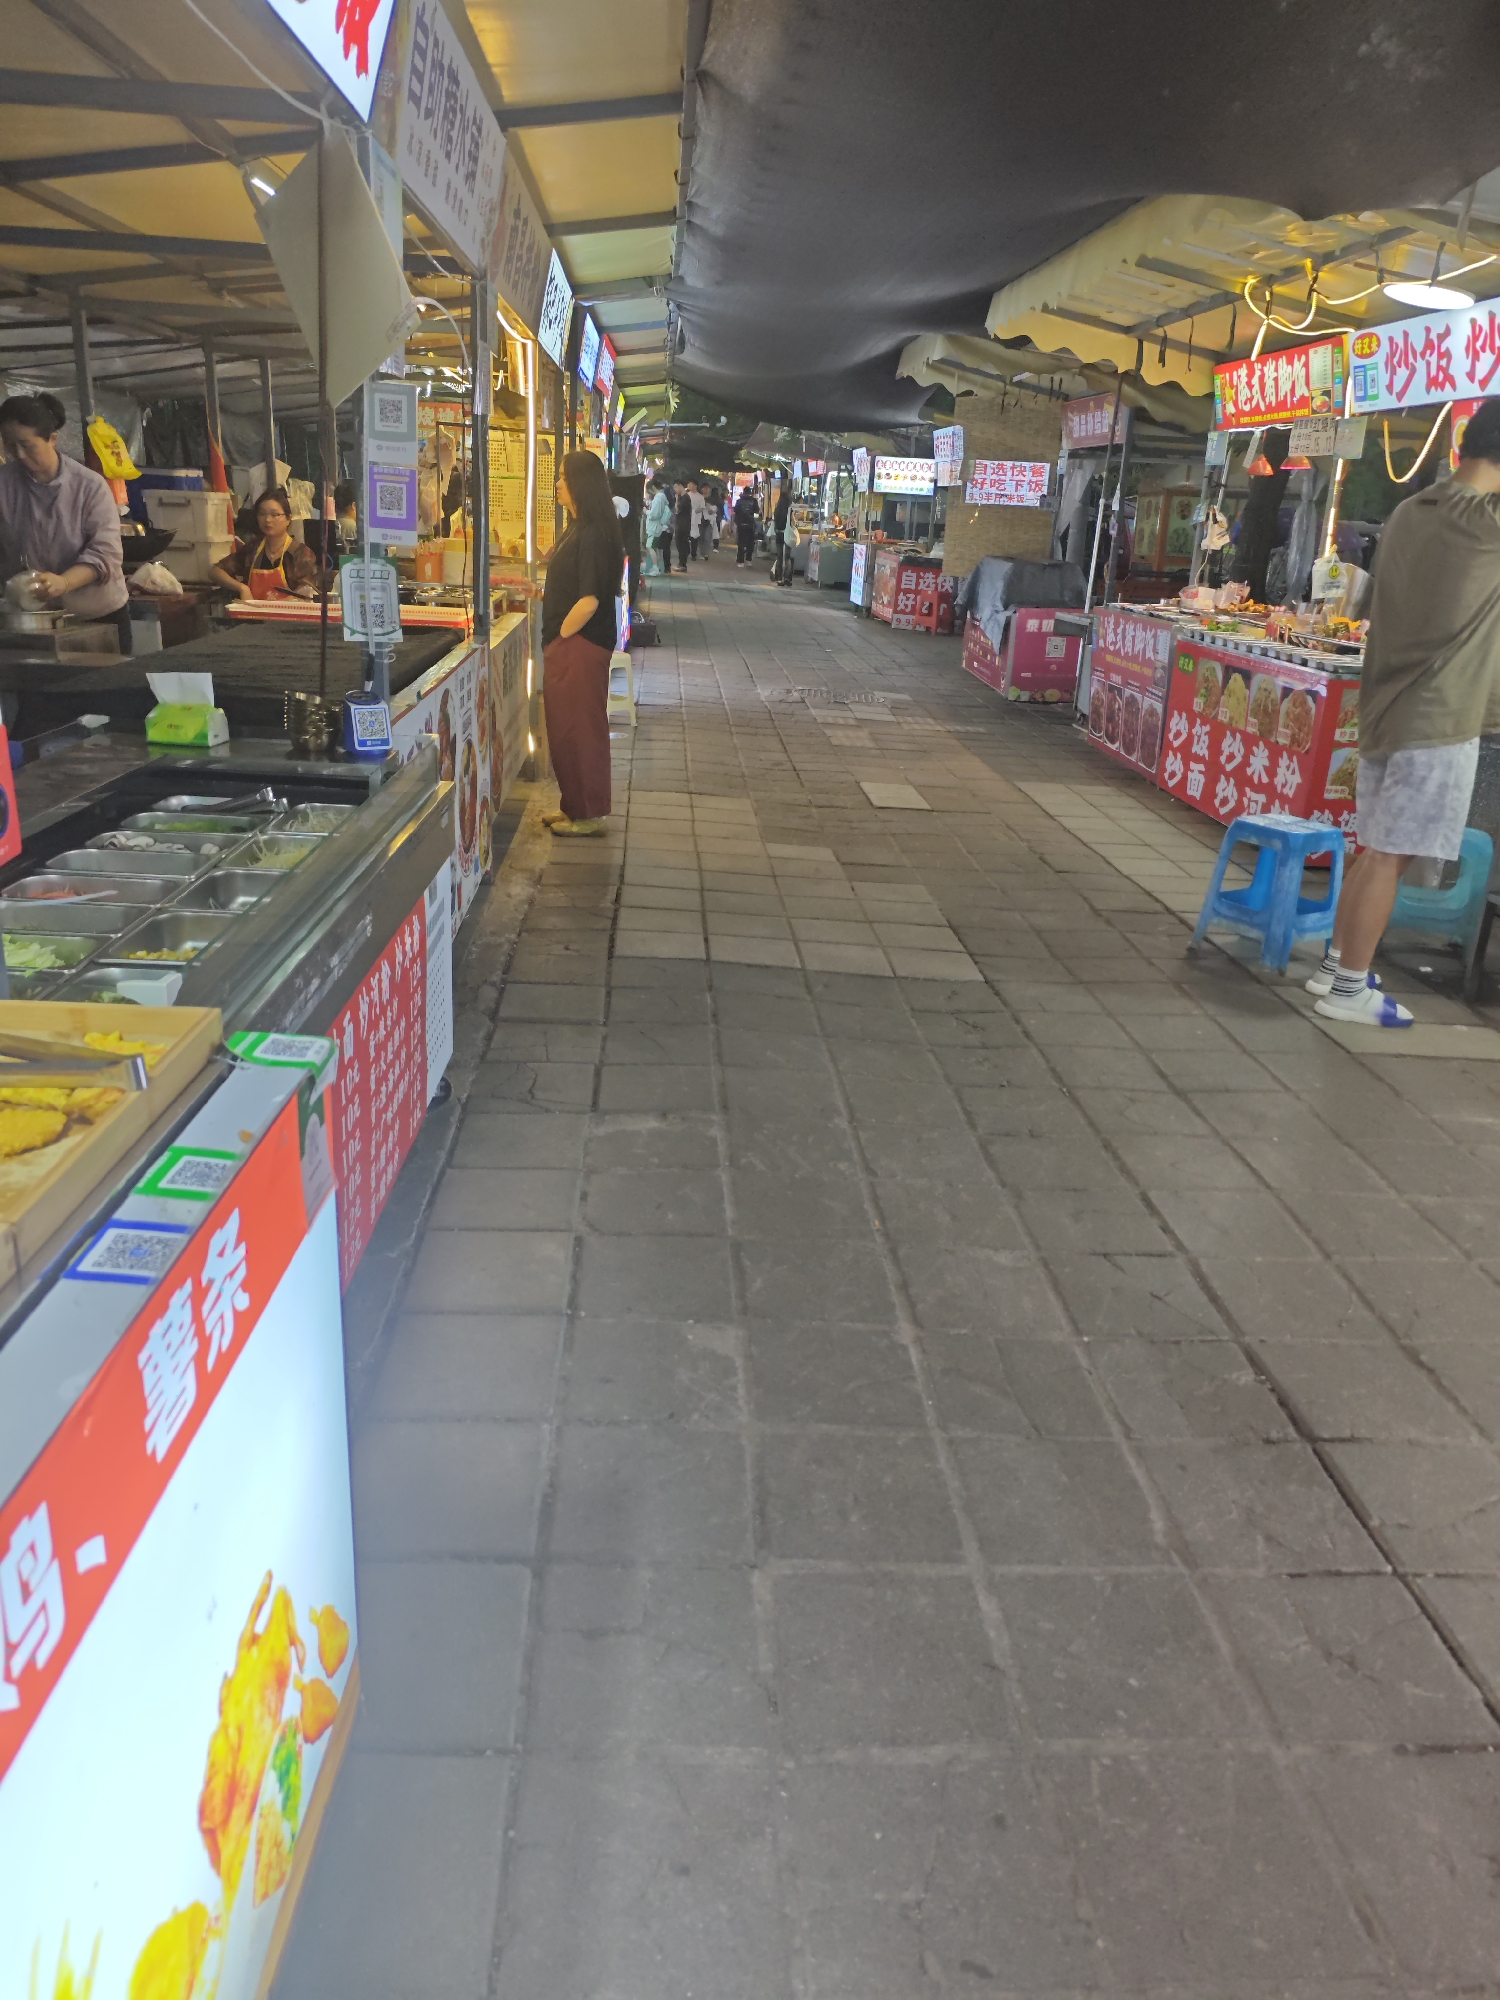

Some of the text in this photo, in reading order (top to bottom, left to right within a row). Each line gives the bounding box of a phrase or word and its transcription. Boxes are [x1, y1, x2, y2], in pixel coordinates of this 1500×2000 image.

[407, 1, 484, 198] 自助糖水铺
[1238, 354, 1309, 411] 港式猪脚饭
[970, 478, 1044, 493] 好吃下饭
[974, 462, 1046, 478] 自选快餐
[1105, 614, 1156, 661] 港式猪脚饭
[1169, 710, 1302, 798] 炒饭 炒米粉
[1340, 730, 1356, 740] 炒面
[1164, 750, 1206, 800] 炒面
[1325, 786, 1349, 796] 炒米粉
[359, 958, 392, 1041] 炒河粉
[395, 914, 421, 984] 炒米粉
[341, 1058, 361, 1107] 10元
[410, 957, 422, 994] 12元
[341, 1092, 361, 1143] 10元
[410, 985, 422, 1023] 12元
[342, 1127, 362, 1178] 10元
[410, 1015, 422, 1053] 12元
[343, 1161, 362, 1212] 10元
[343, 1194, 362, 1247] 12元
[344, 1227, 362, 1280] 12元
